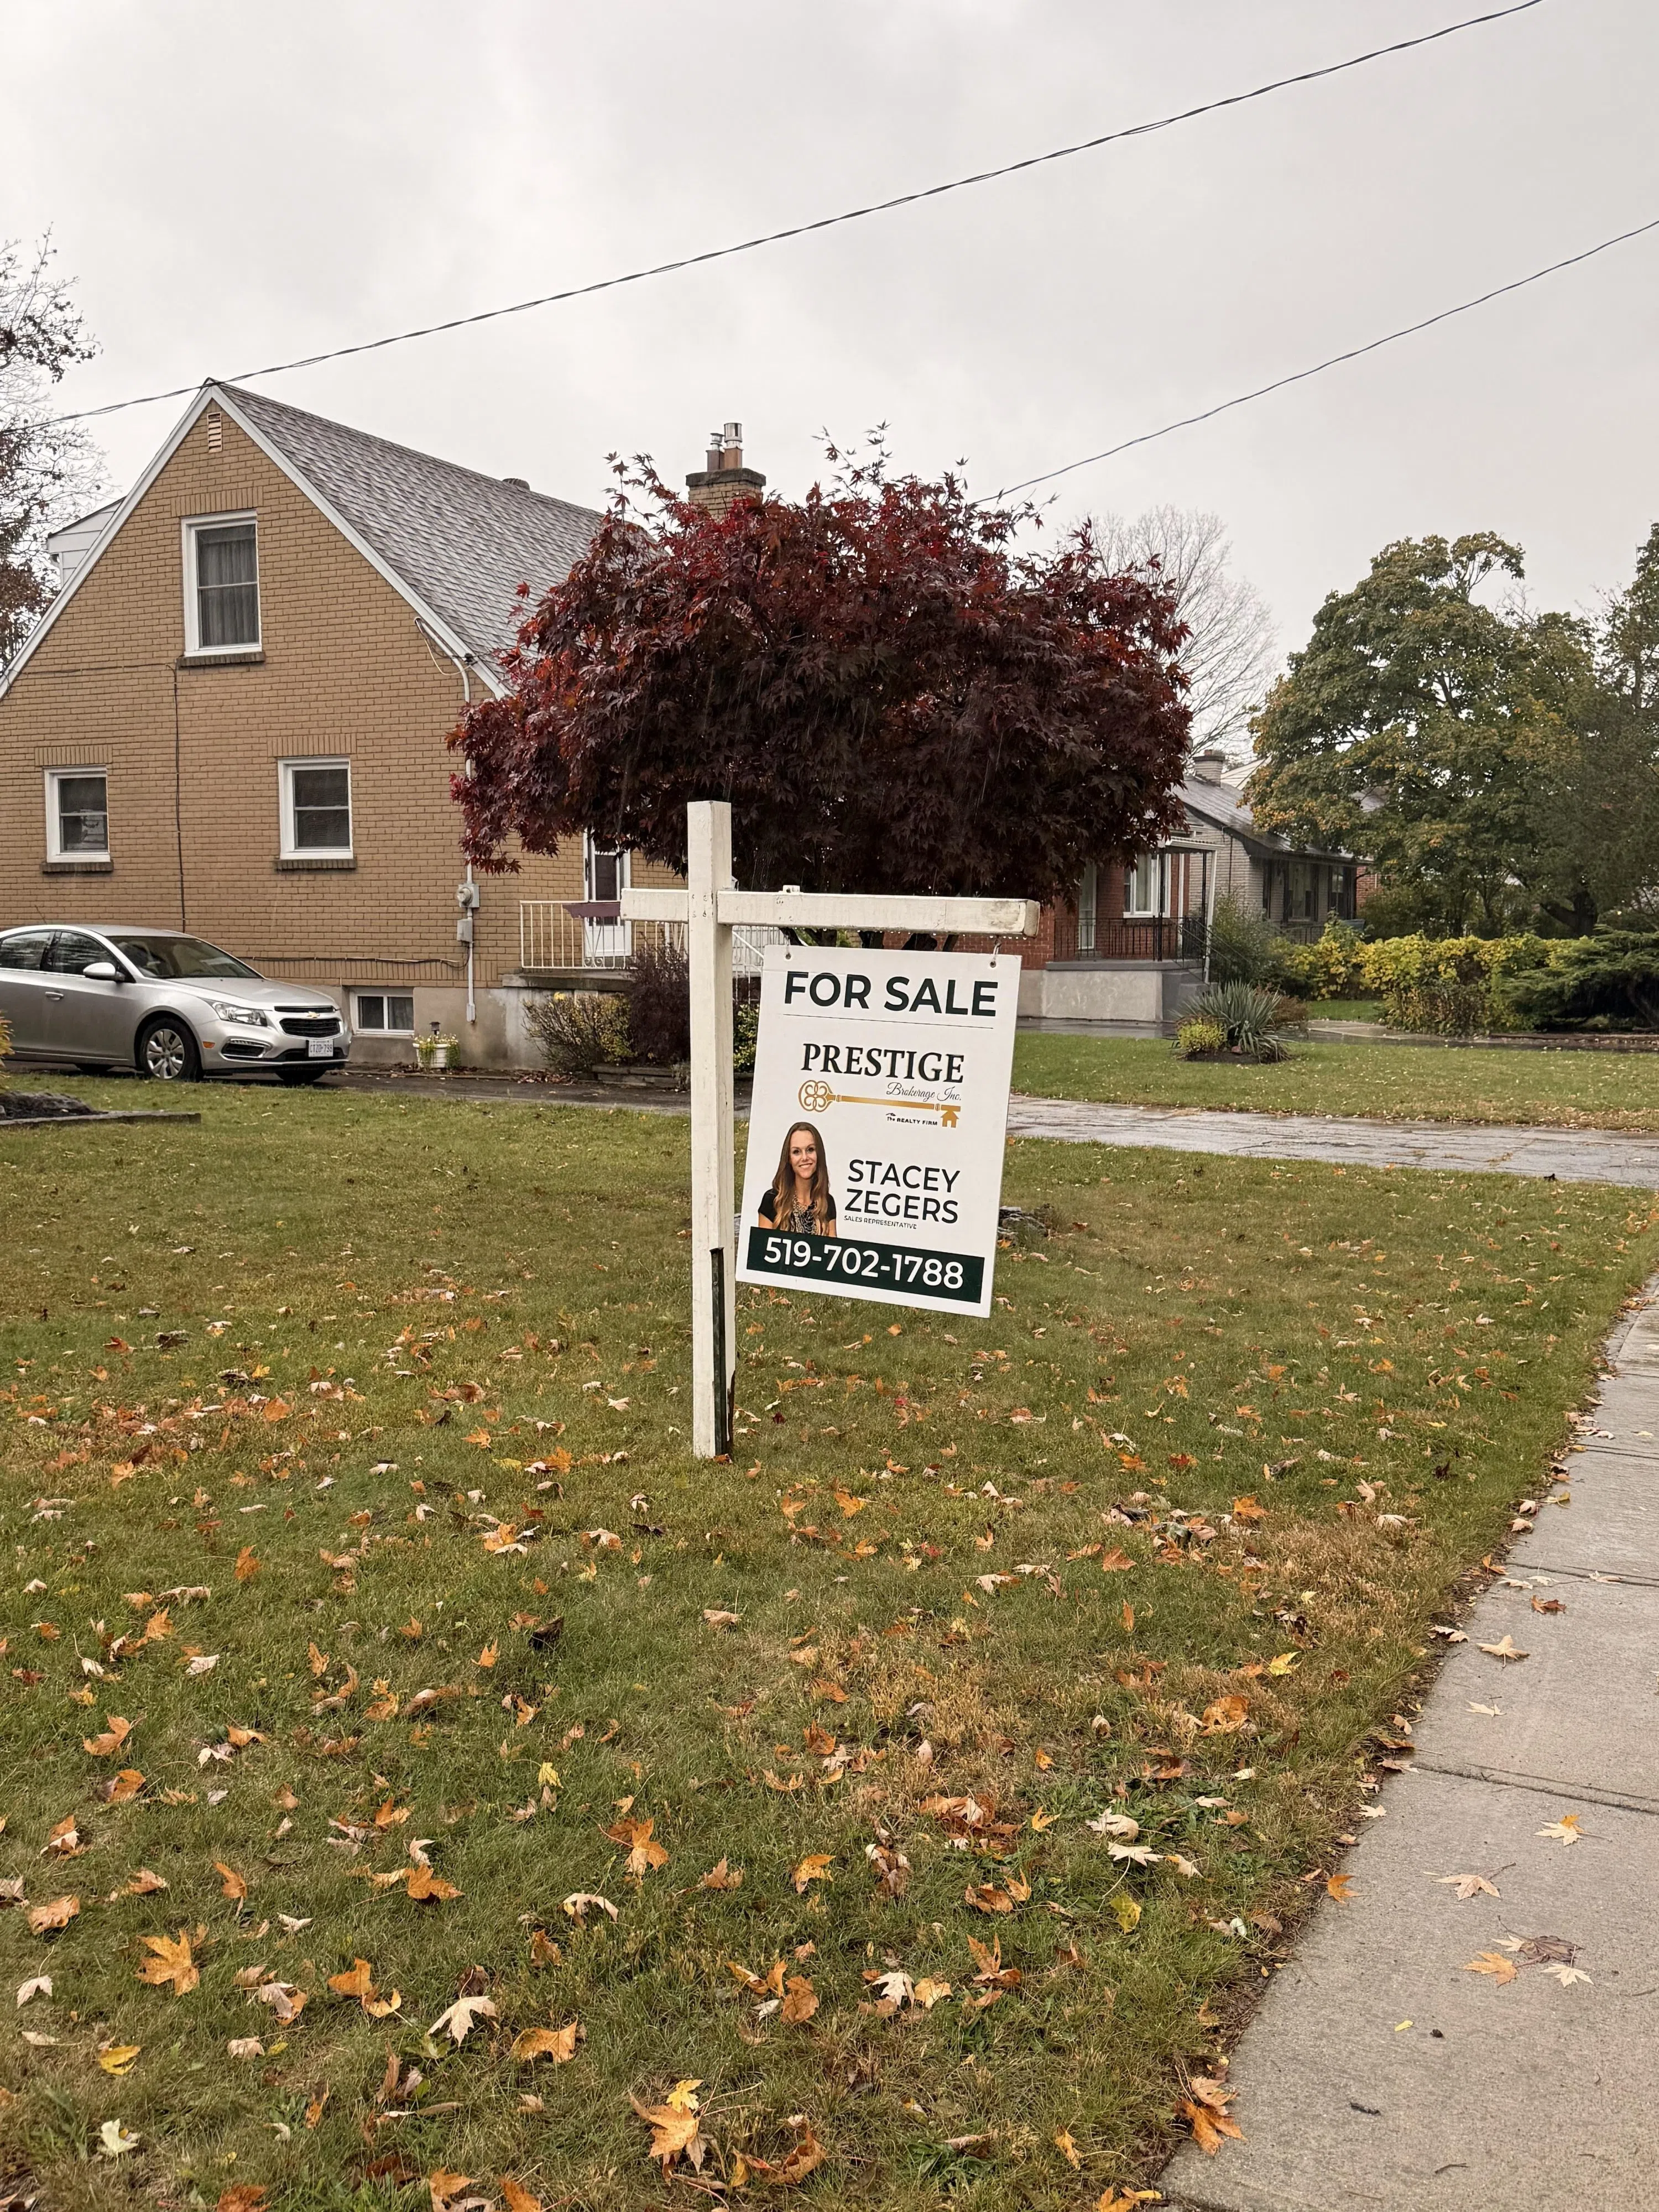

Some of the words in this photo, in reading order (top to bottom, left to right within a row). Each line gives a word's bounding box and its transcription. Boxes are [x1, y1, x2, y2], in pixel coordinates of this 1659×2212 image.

[784, 971, 872, 1009] FOR
[884, 976, 998, 1016] SALE
[801, 1043, 964, 1083] PRESTIGE
[886, 1082, 935, 1102] Brokerage
[936, 1086, 961, 1102] Inc.
[848, 1159, 961, 1193] STACEY
[844, 1188, 958, 1224] ZEGERS
[863, 1218, 917, 1229] REPRESENTATIVE
[764, 1237, 963, 1289] 519-702-1788
